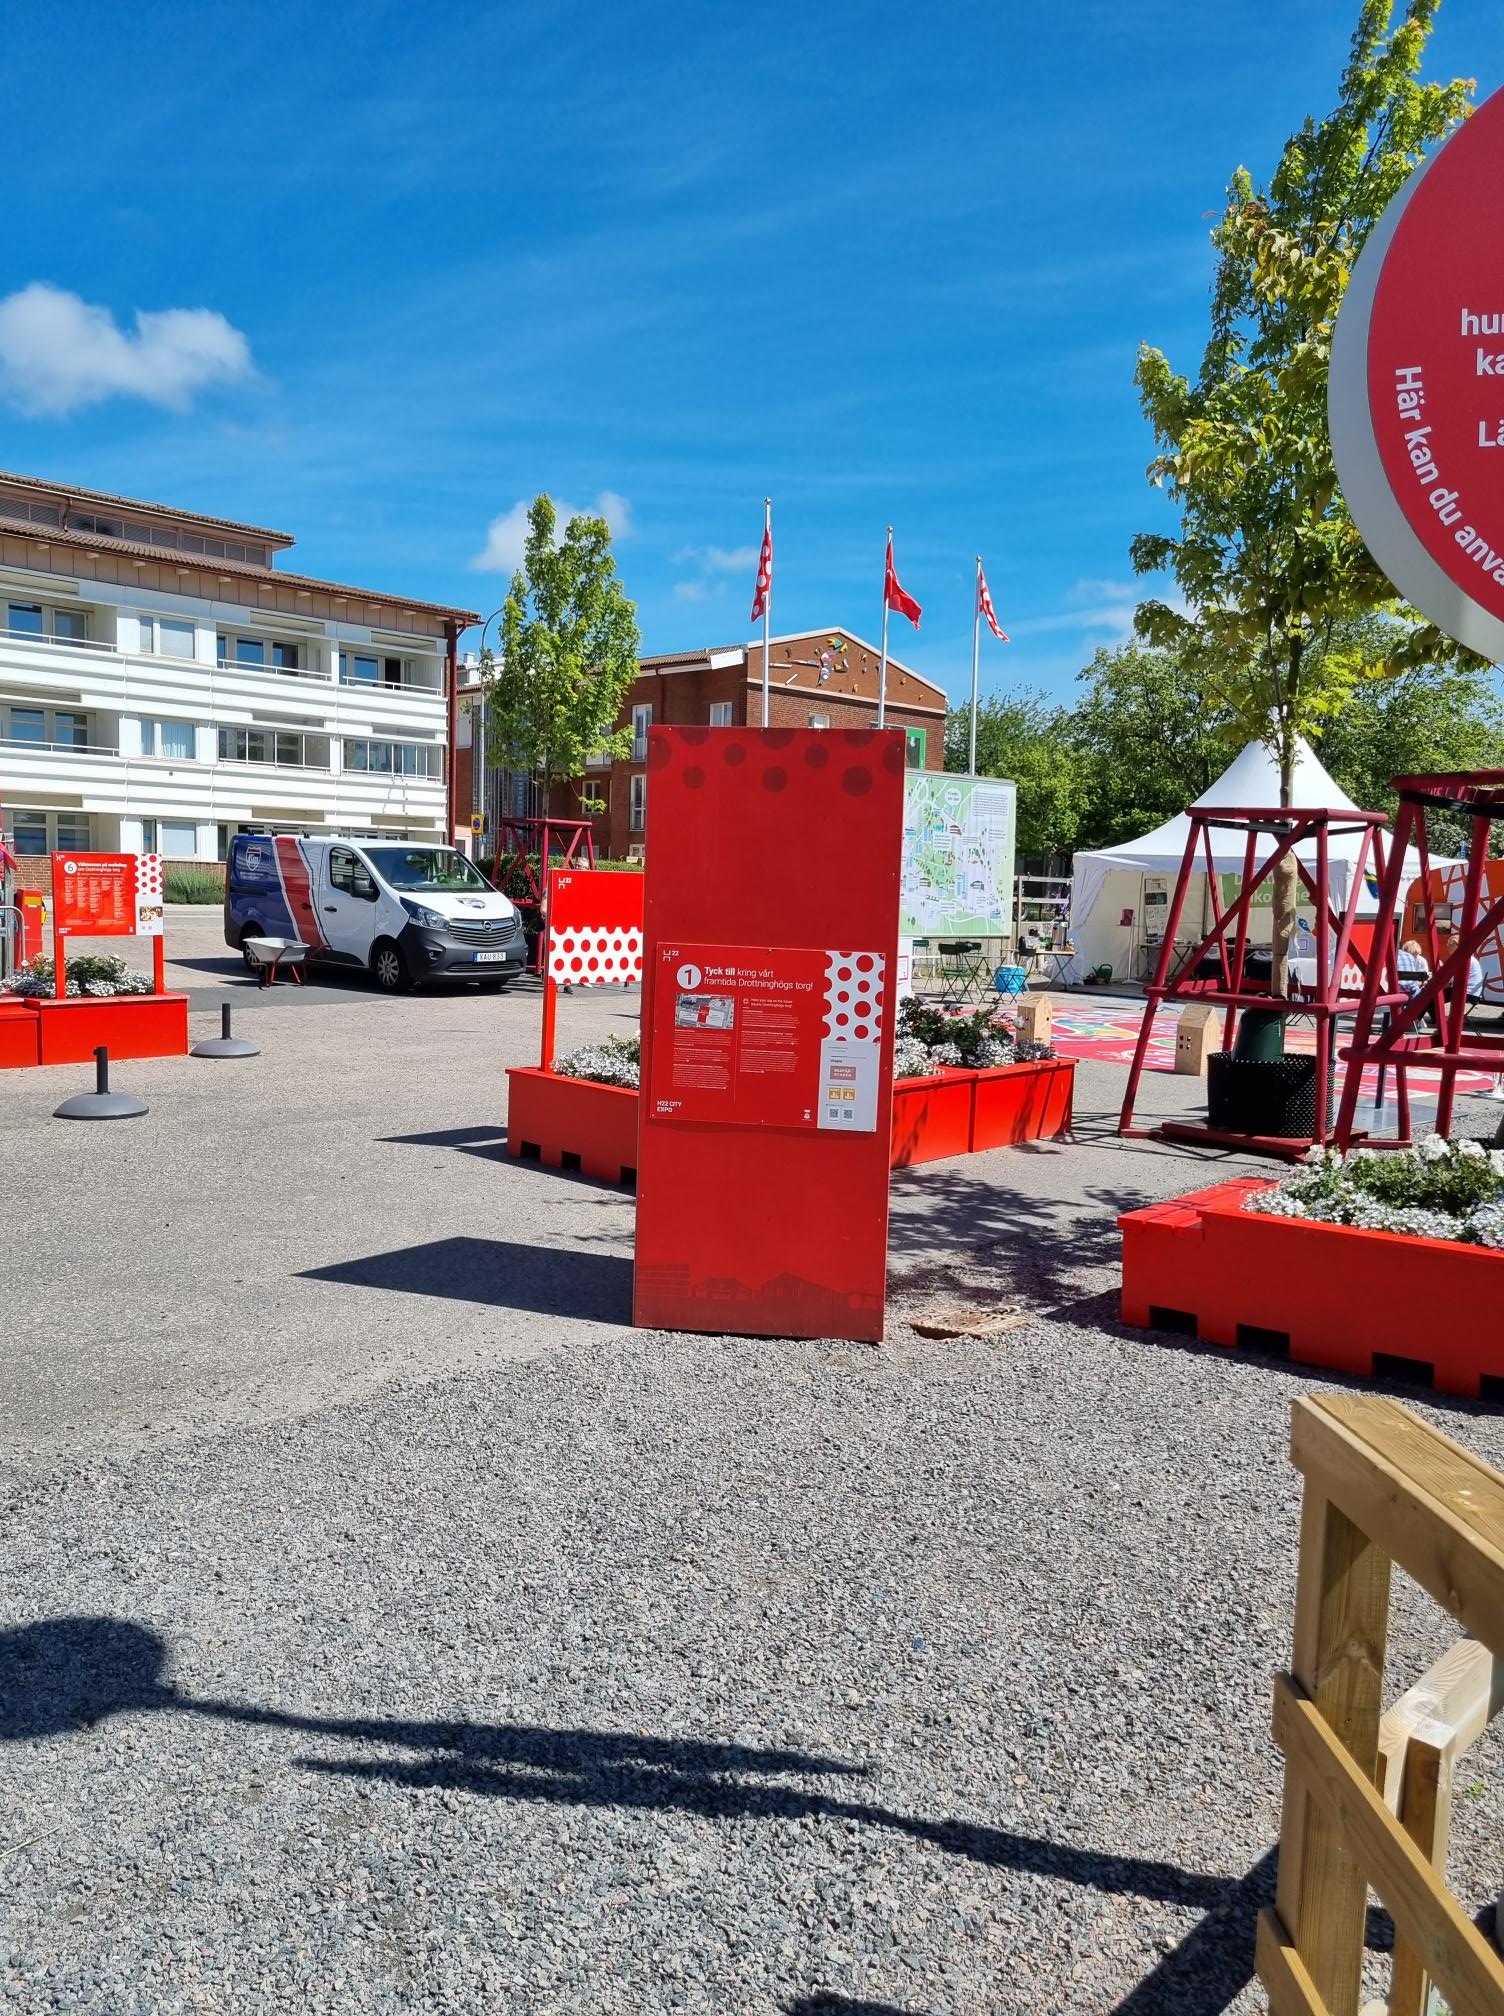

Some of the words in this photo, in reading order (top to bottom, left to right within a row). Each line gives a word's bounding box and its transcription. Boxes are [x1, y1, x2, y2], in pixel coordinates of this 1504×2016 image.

[1461, 308, 1504, 336] hu
[1395, 366, 1425, 421] Här
[1404, 426, 1439, 485] kan
[1429, 488, 1462, 527] du
[684, 968, 693, 986] 1
[704, 966, 723, 977] Tyck
[725, 967, 736, 976] till
[737, 968, 757, 979] kring
[758, 968, 774, 978] vårt
[704, 977, 737, 987] framtida
[738, 979, 794, 990] Drottninghögs
[795, 981, 813, 991] torg!
